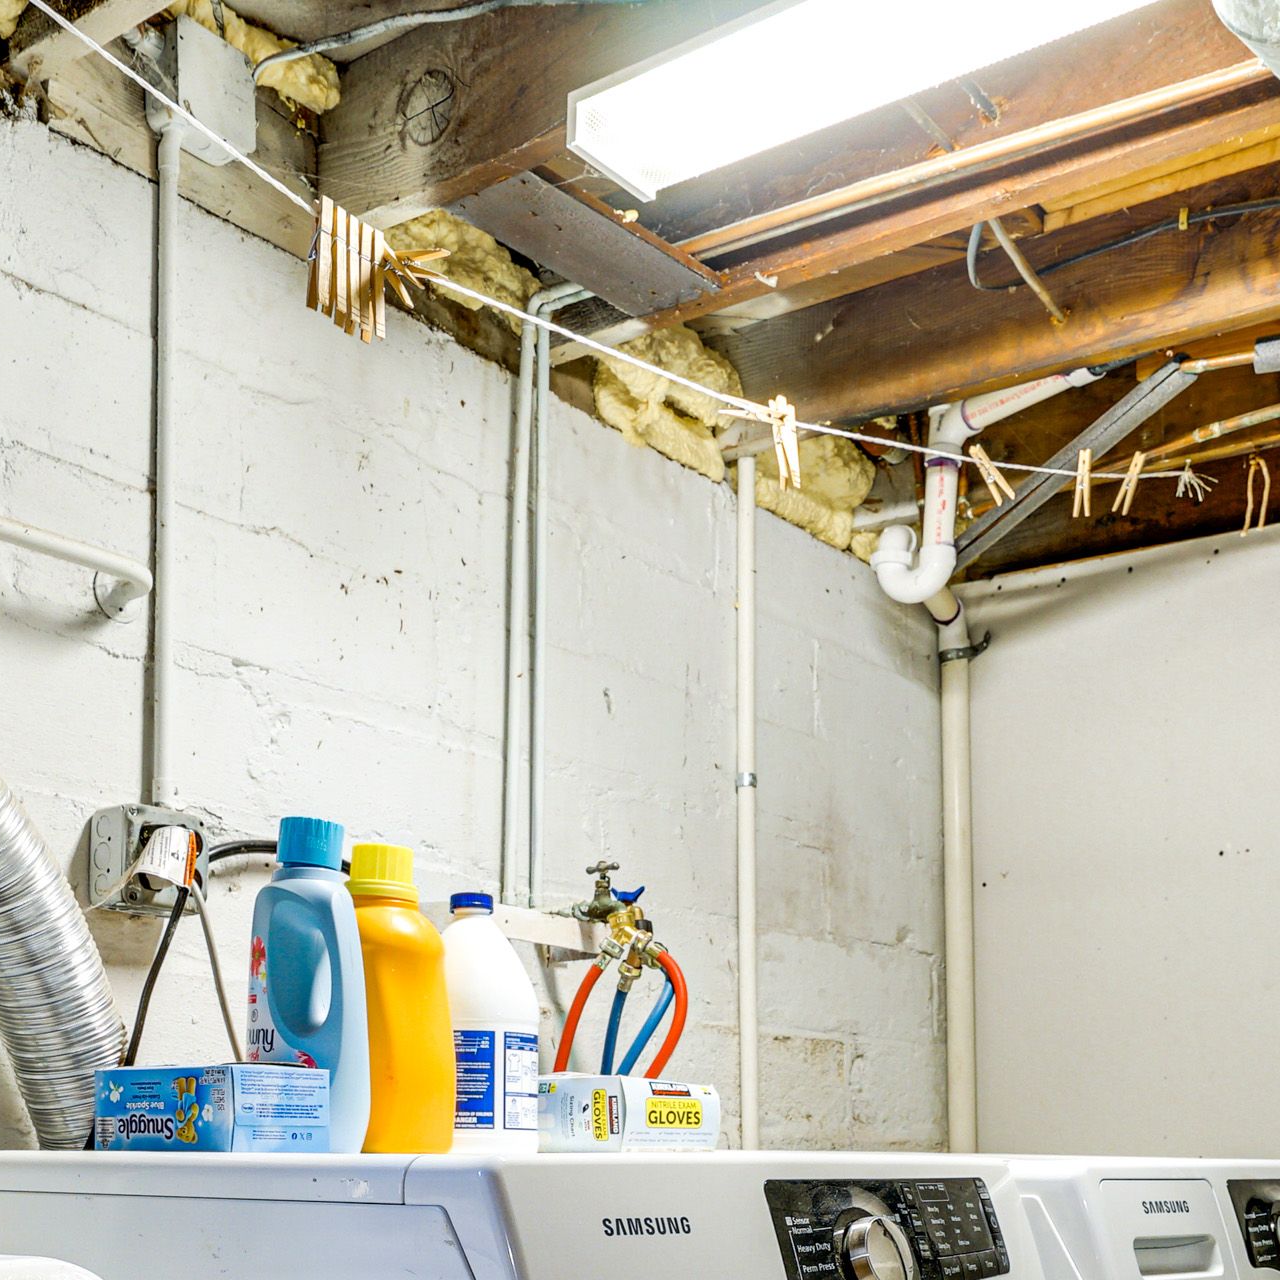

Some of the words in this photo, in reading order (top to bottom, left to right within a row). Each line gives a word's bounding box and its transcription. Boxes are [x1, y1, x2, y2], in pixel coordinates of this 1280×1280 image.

[248, 1028, 275, 1053] wny
[126, 1101, 150, 1111] Sparkle
[150, 1102, 165, 1110] Blue
[651, 1100, 676, 1109] NITRILE
[678, 1101, 696, 1110] EXAM
[593, 1091, 602, 1139] GLOVES
[648, 1110, 701, 1125] GLOVES
[117, 1114, 174, 1140] Snuggle
[1141, 1200, 1190, 1215] SAMSUNG
[602, 1216, 691, 1237] SAMSUNG
[792, 1226, 814, 1234] Normal
[797, 1245, 816, 1254] Heavy
[816, 1243, 831, 1252] Duty
[802, 1265, 818, 1273] Perm
[818, 1263, 836, 1272] Press
